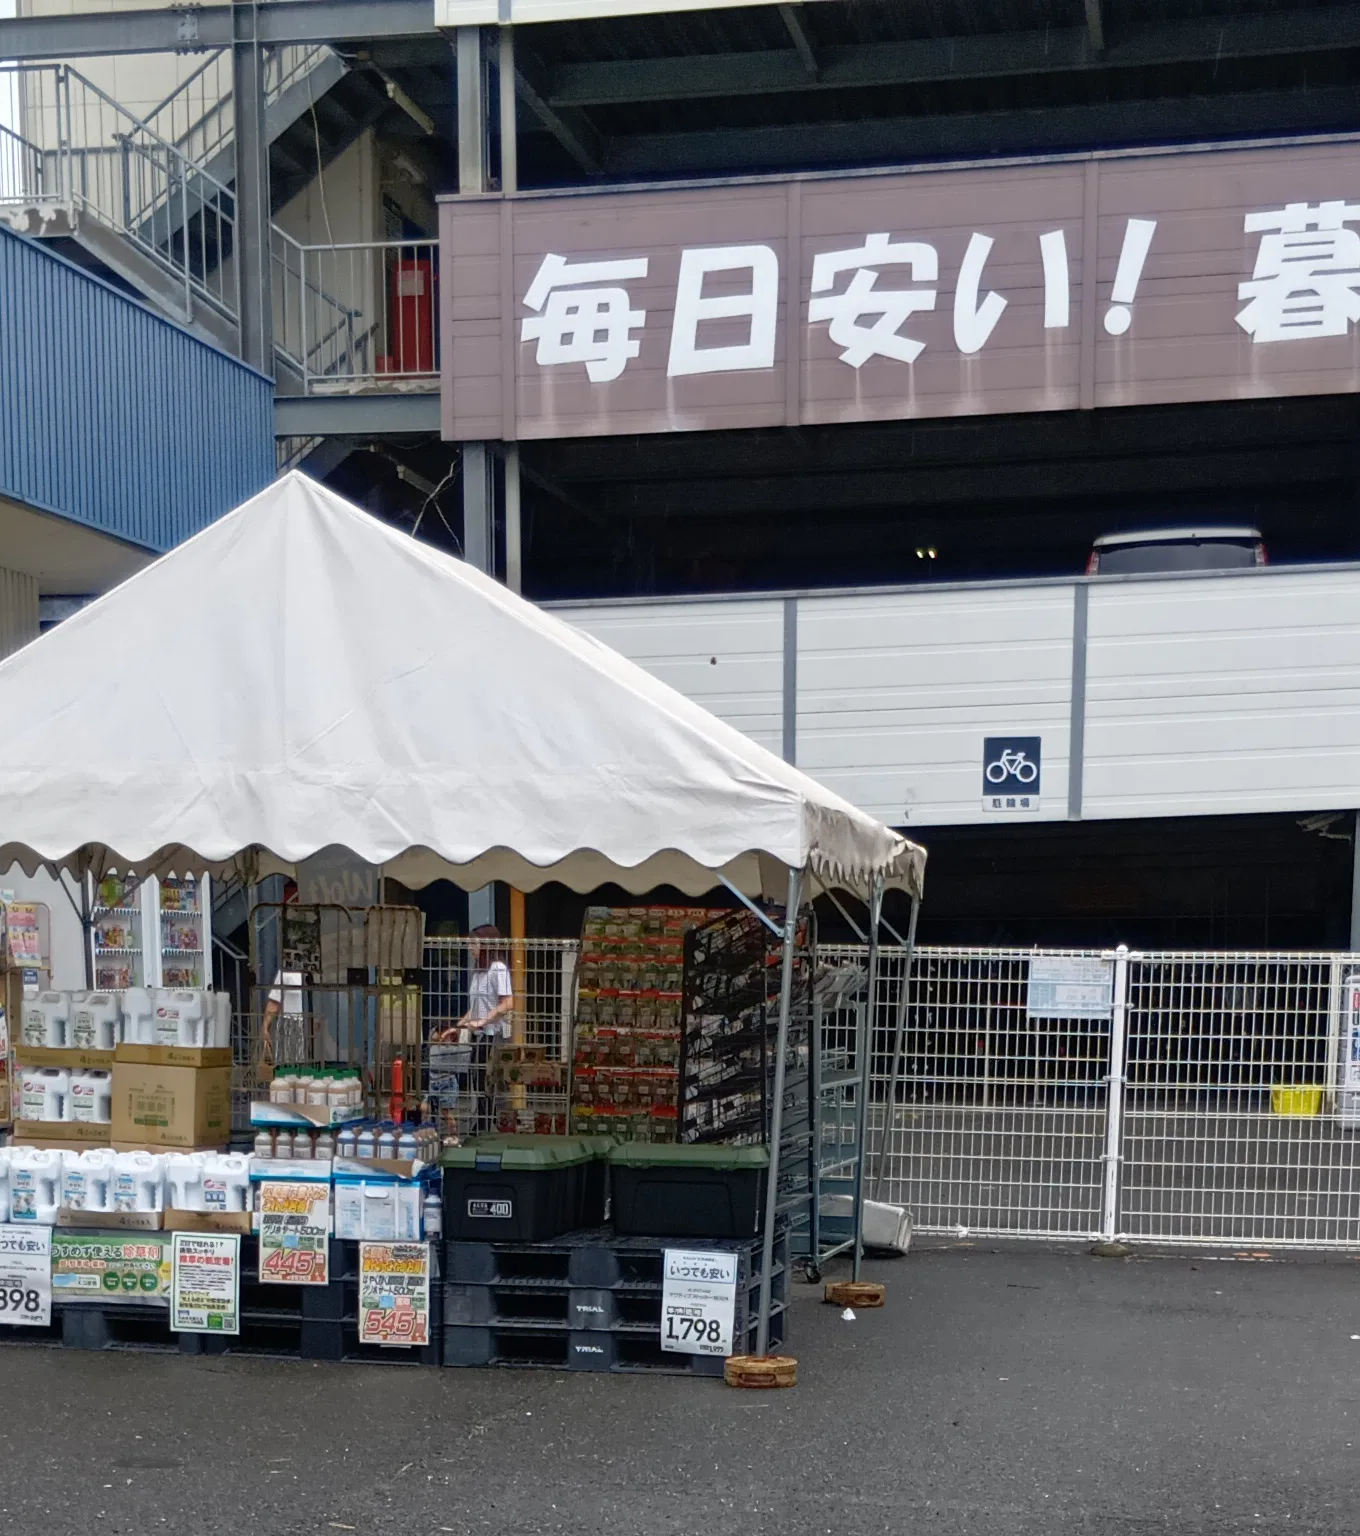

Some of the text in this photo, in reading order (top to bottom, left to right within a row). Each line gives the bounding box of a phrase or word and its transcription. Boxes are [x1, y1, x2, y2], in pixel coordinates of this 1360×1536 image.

[520, 219, 1156, 383] 毎日安い!
[262, 1248, 315, 1275] 445
[670, 1265, 729, 1279] いつでも安い
[363, 1309, 417, 1335] 545
[576, 1305, 605, 1313] TRIAL
[666, 1317, 721, 1343] 1,798
